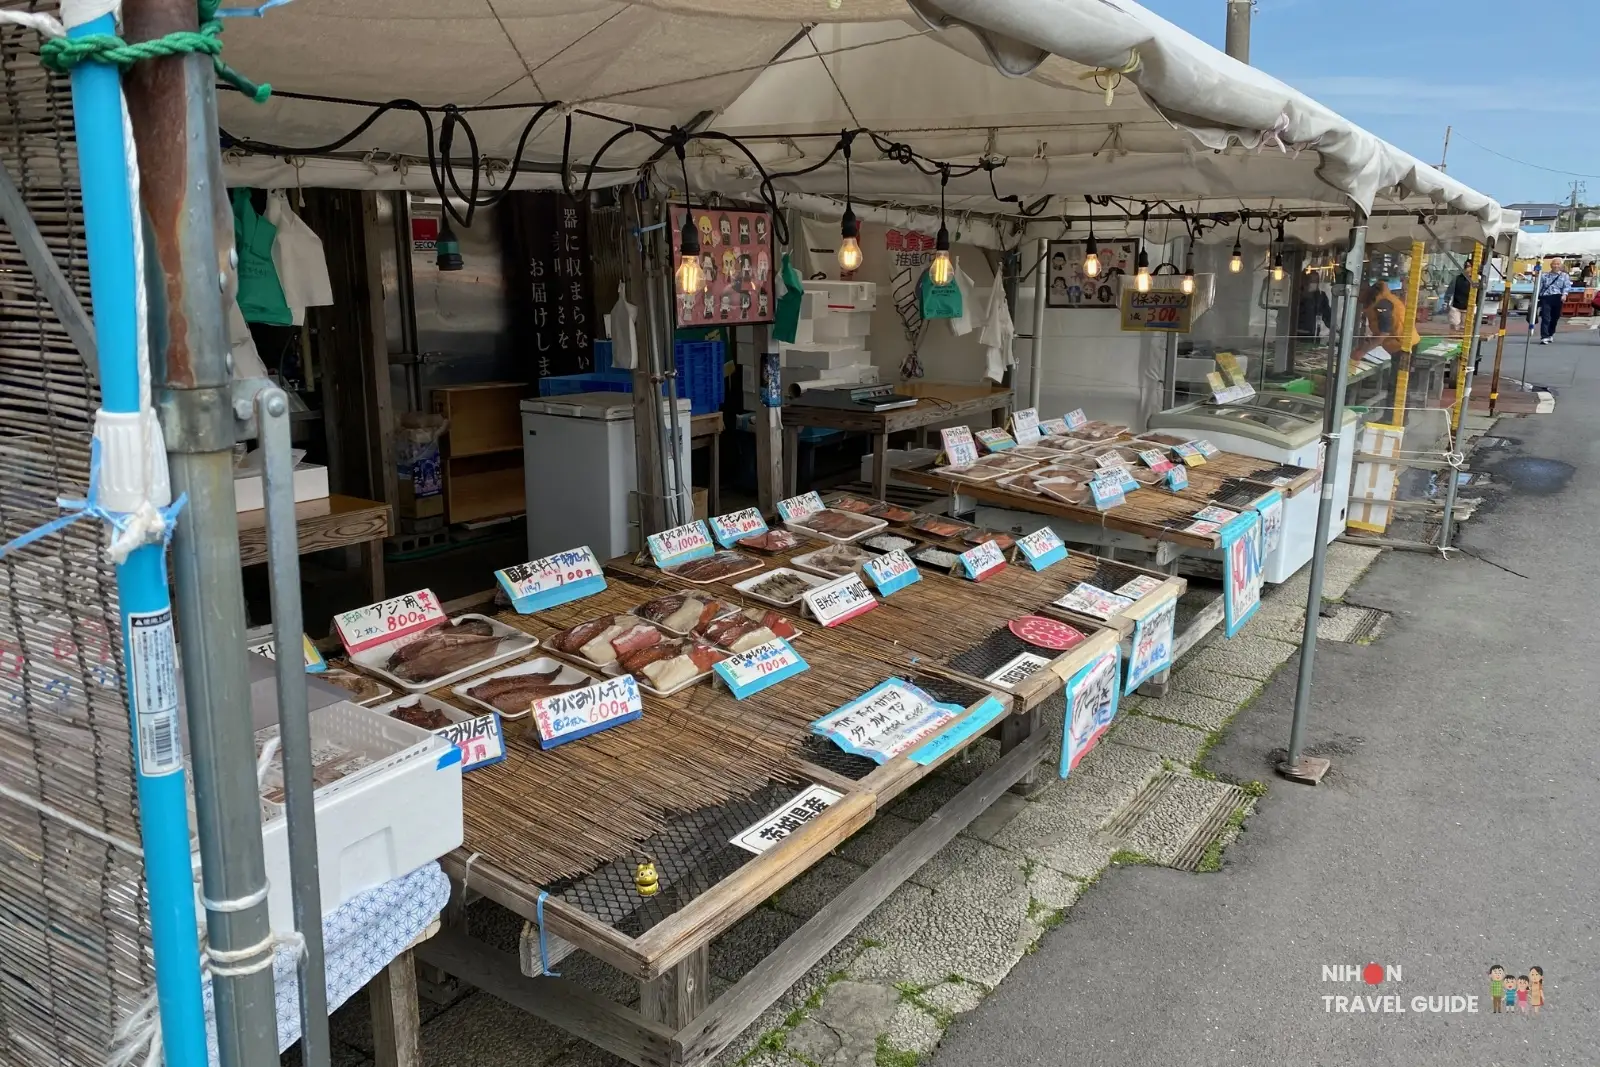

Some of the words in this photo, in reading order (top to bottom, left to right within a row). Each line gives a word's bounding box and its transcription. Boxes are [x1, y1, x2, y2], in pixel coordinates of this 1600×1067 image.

[563, 207, 590, 370] 器に収まらない
[529, 258, 551, 376] お届けしま
[556, 568, 594, 586] 700円
[846, 580, 872, 602] 540円
[387, 611, 427, 631] 800円
[756, 656, 789, 675] 700円
[548, 680, 626, 716] サバみりん干し
[589, 699, 629, 723] 600円
[759, 796, 831, 843] 茨城県産
